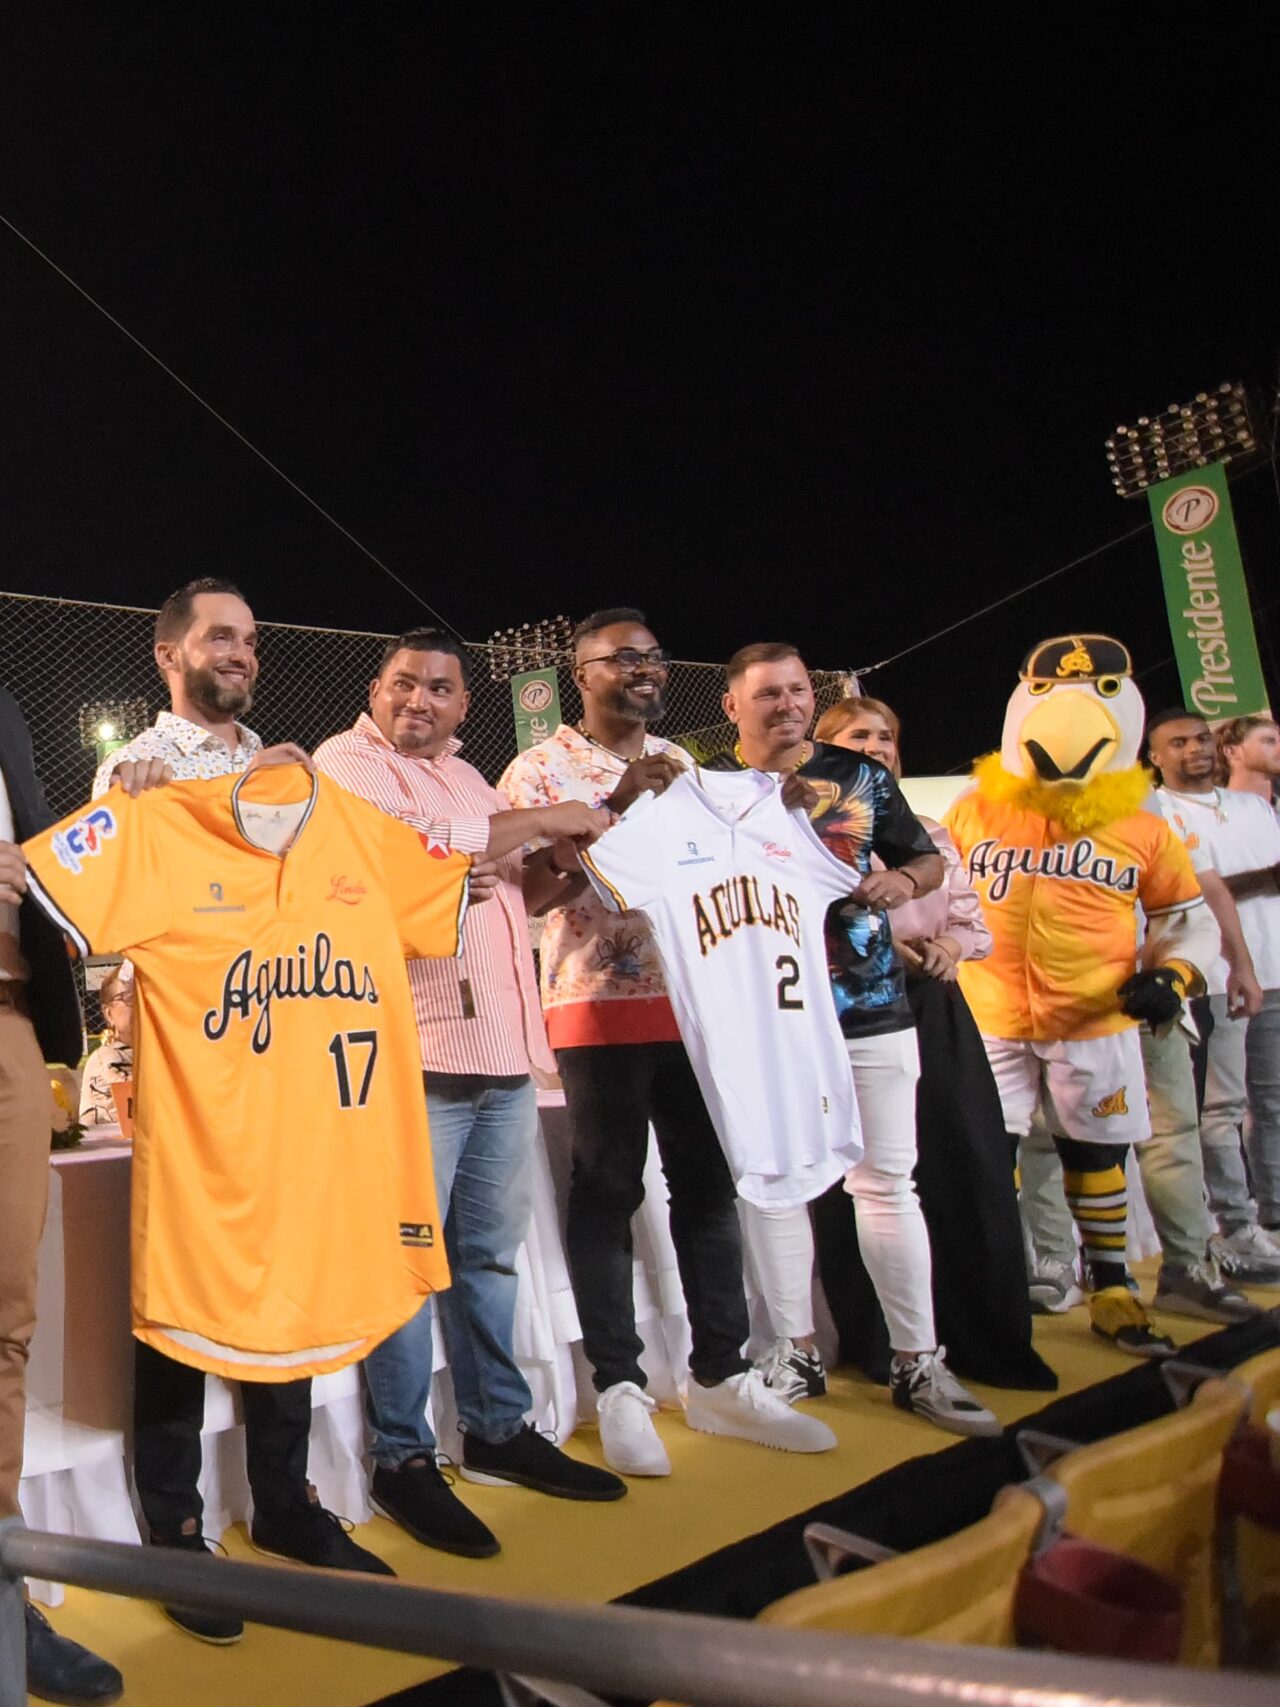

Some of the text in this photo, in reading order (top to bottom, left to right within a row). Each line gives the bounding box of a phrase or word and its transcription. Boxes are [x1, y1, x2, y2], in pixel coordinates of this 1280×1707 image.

[1181, 540, 1238, 716] Presidente
[969, 838, 1138, 902] Aguilas
[203, 932, 380, 1054] Aguilas
[775, 954, 804, 1010] 2
[328, 1030, 379, 1110] 17
